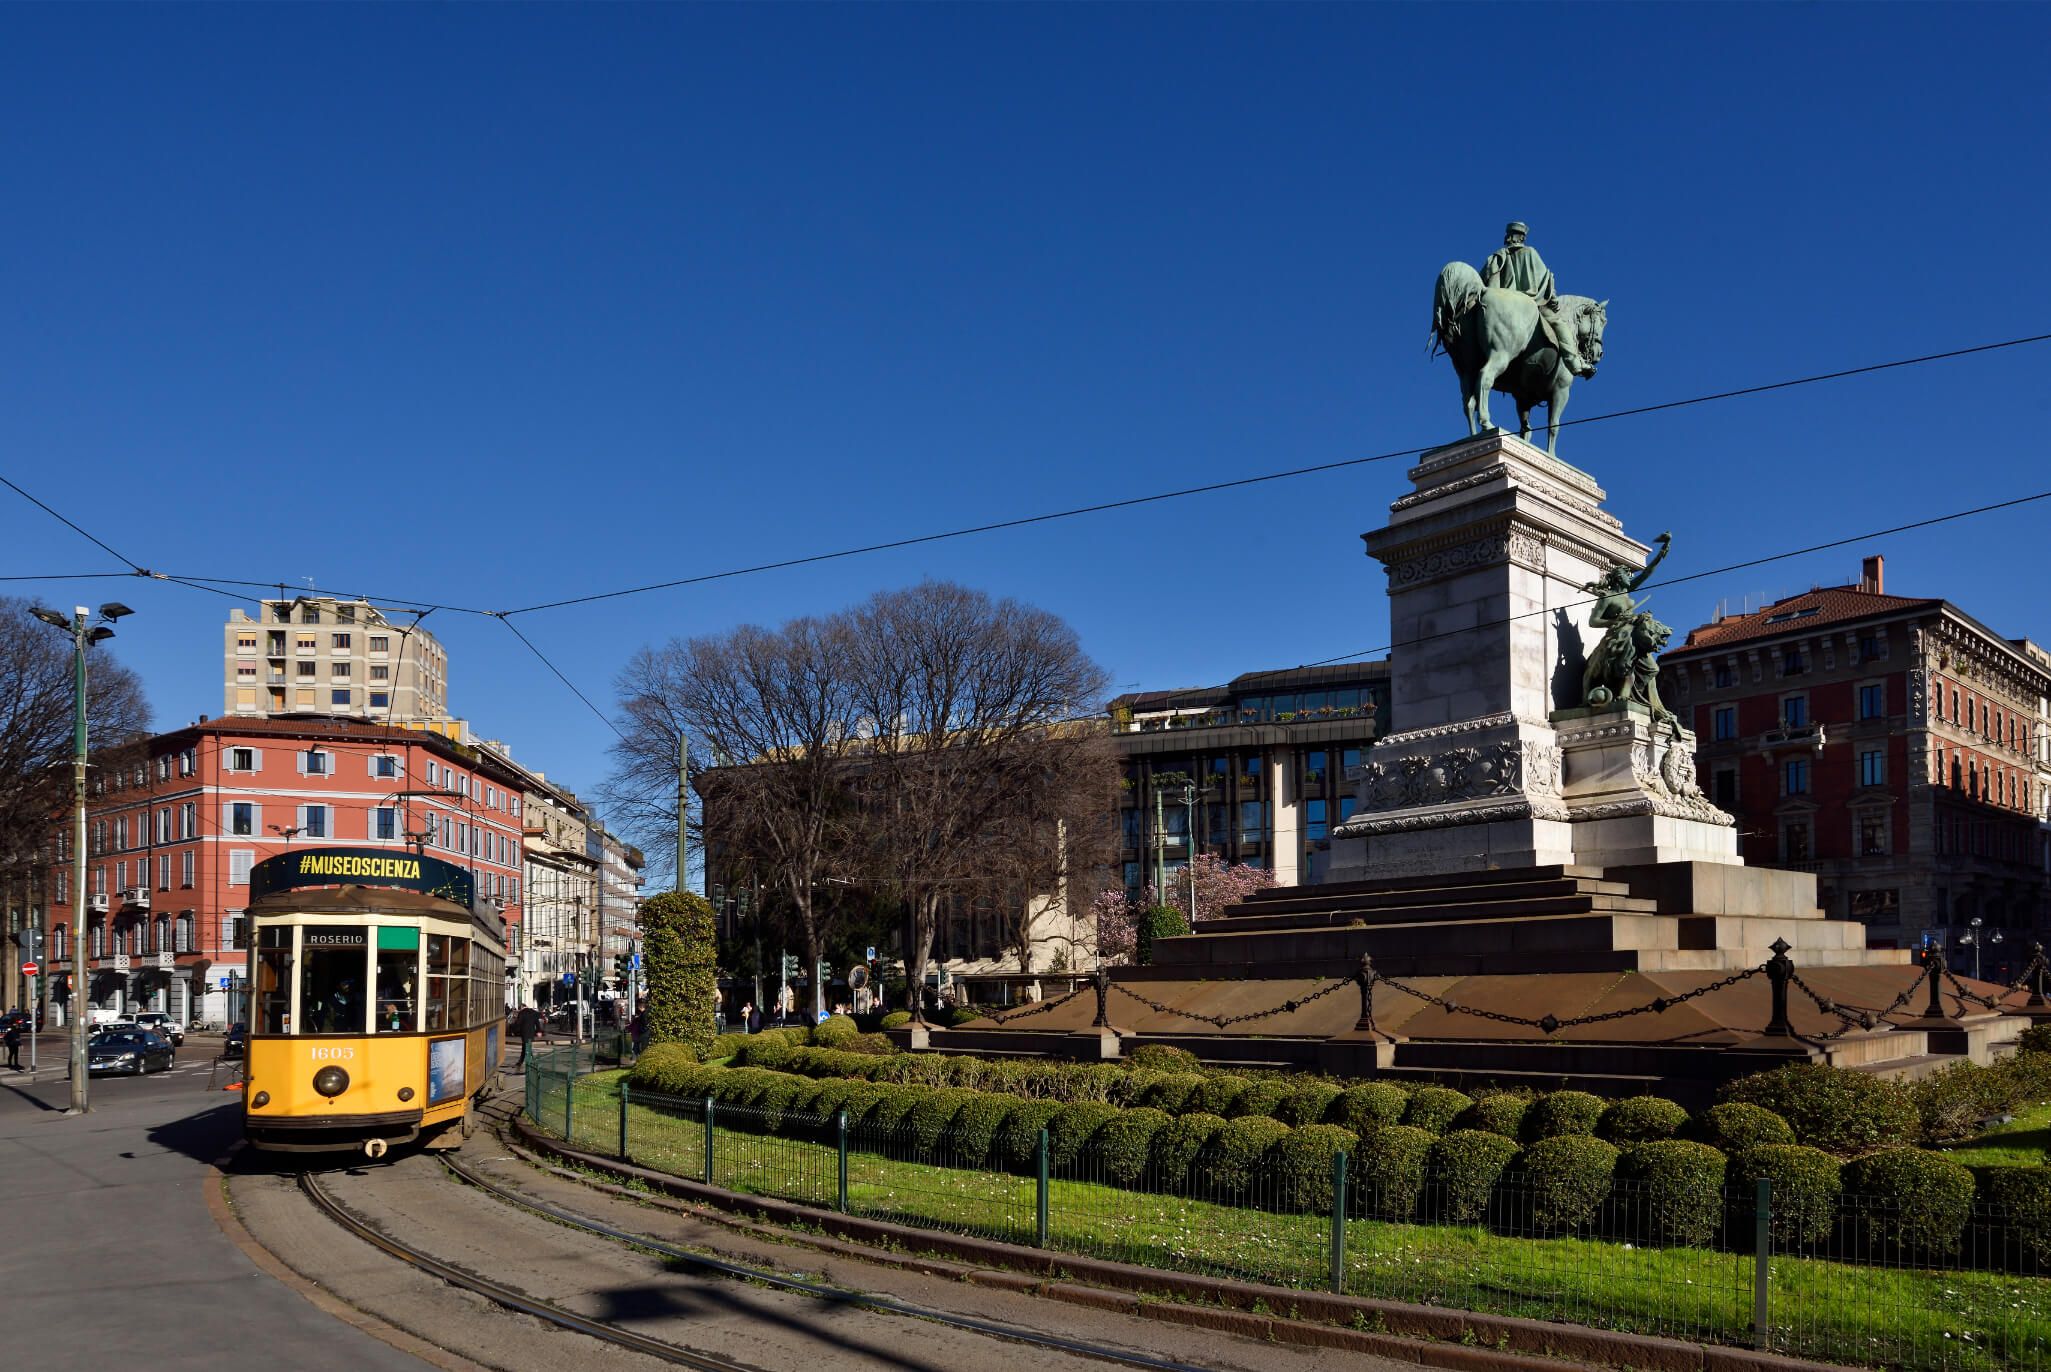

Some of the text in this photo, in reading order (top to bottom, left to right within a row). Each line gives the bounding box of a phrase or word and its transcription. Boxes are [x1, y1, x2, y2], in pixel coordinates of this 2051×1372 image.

[300, 856, 420, 879] #MUSEOSCIENZA
[310, 935, 363, 944] ROSERIO
[311, 1047, 354, 1060] 1605
